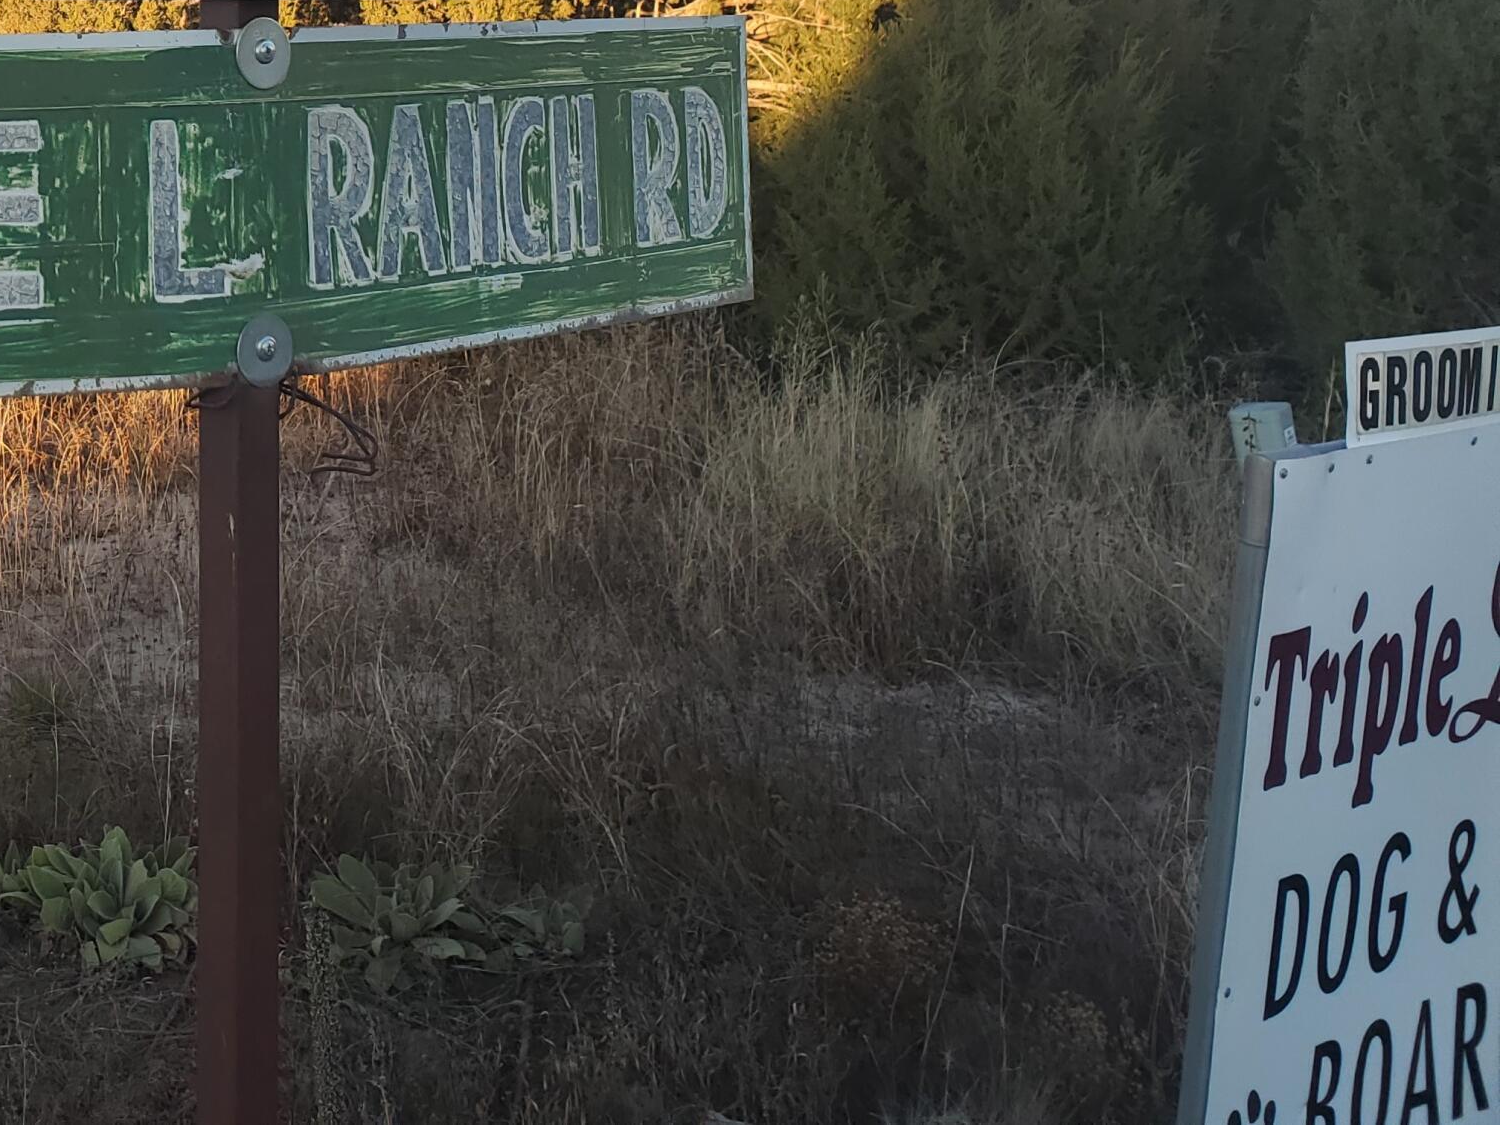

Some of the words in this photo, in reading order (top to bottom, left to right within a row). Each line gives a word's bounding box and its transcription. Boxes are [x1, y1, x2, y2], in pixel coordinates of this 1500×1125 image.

[148, 119, 236, 305] L
[306, 94, 601, 290] RANCH
[629, 87, 726, 248] RD
[1359, 344, 1499, 432] GROOMI
[1262, 584, 1462, 809] Triple
[1262, 831, 1412, 1022] DOG
[1437, 818, 1480, 944] &
